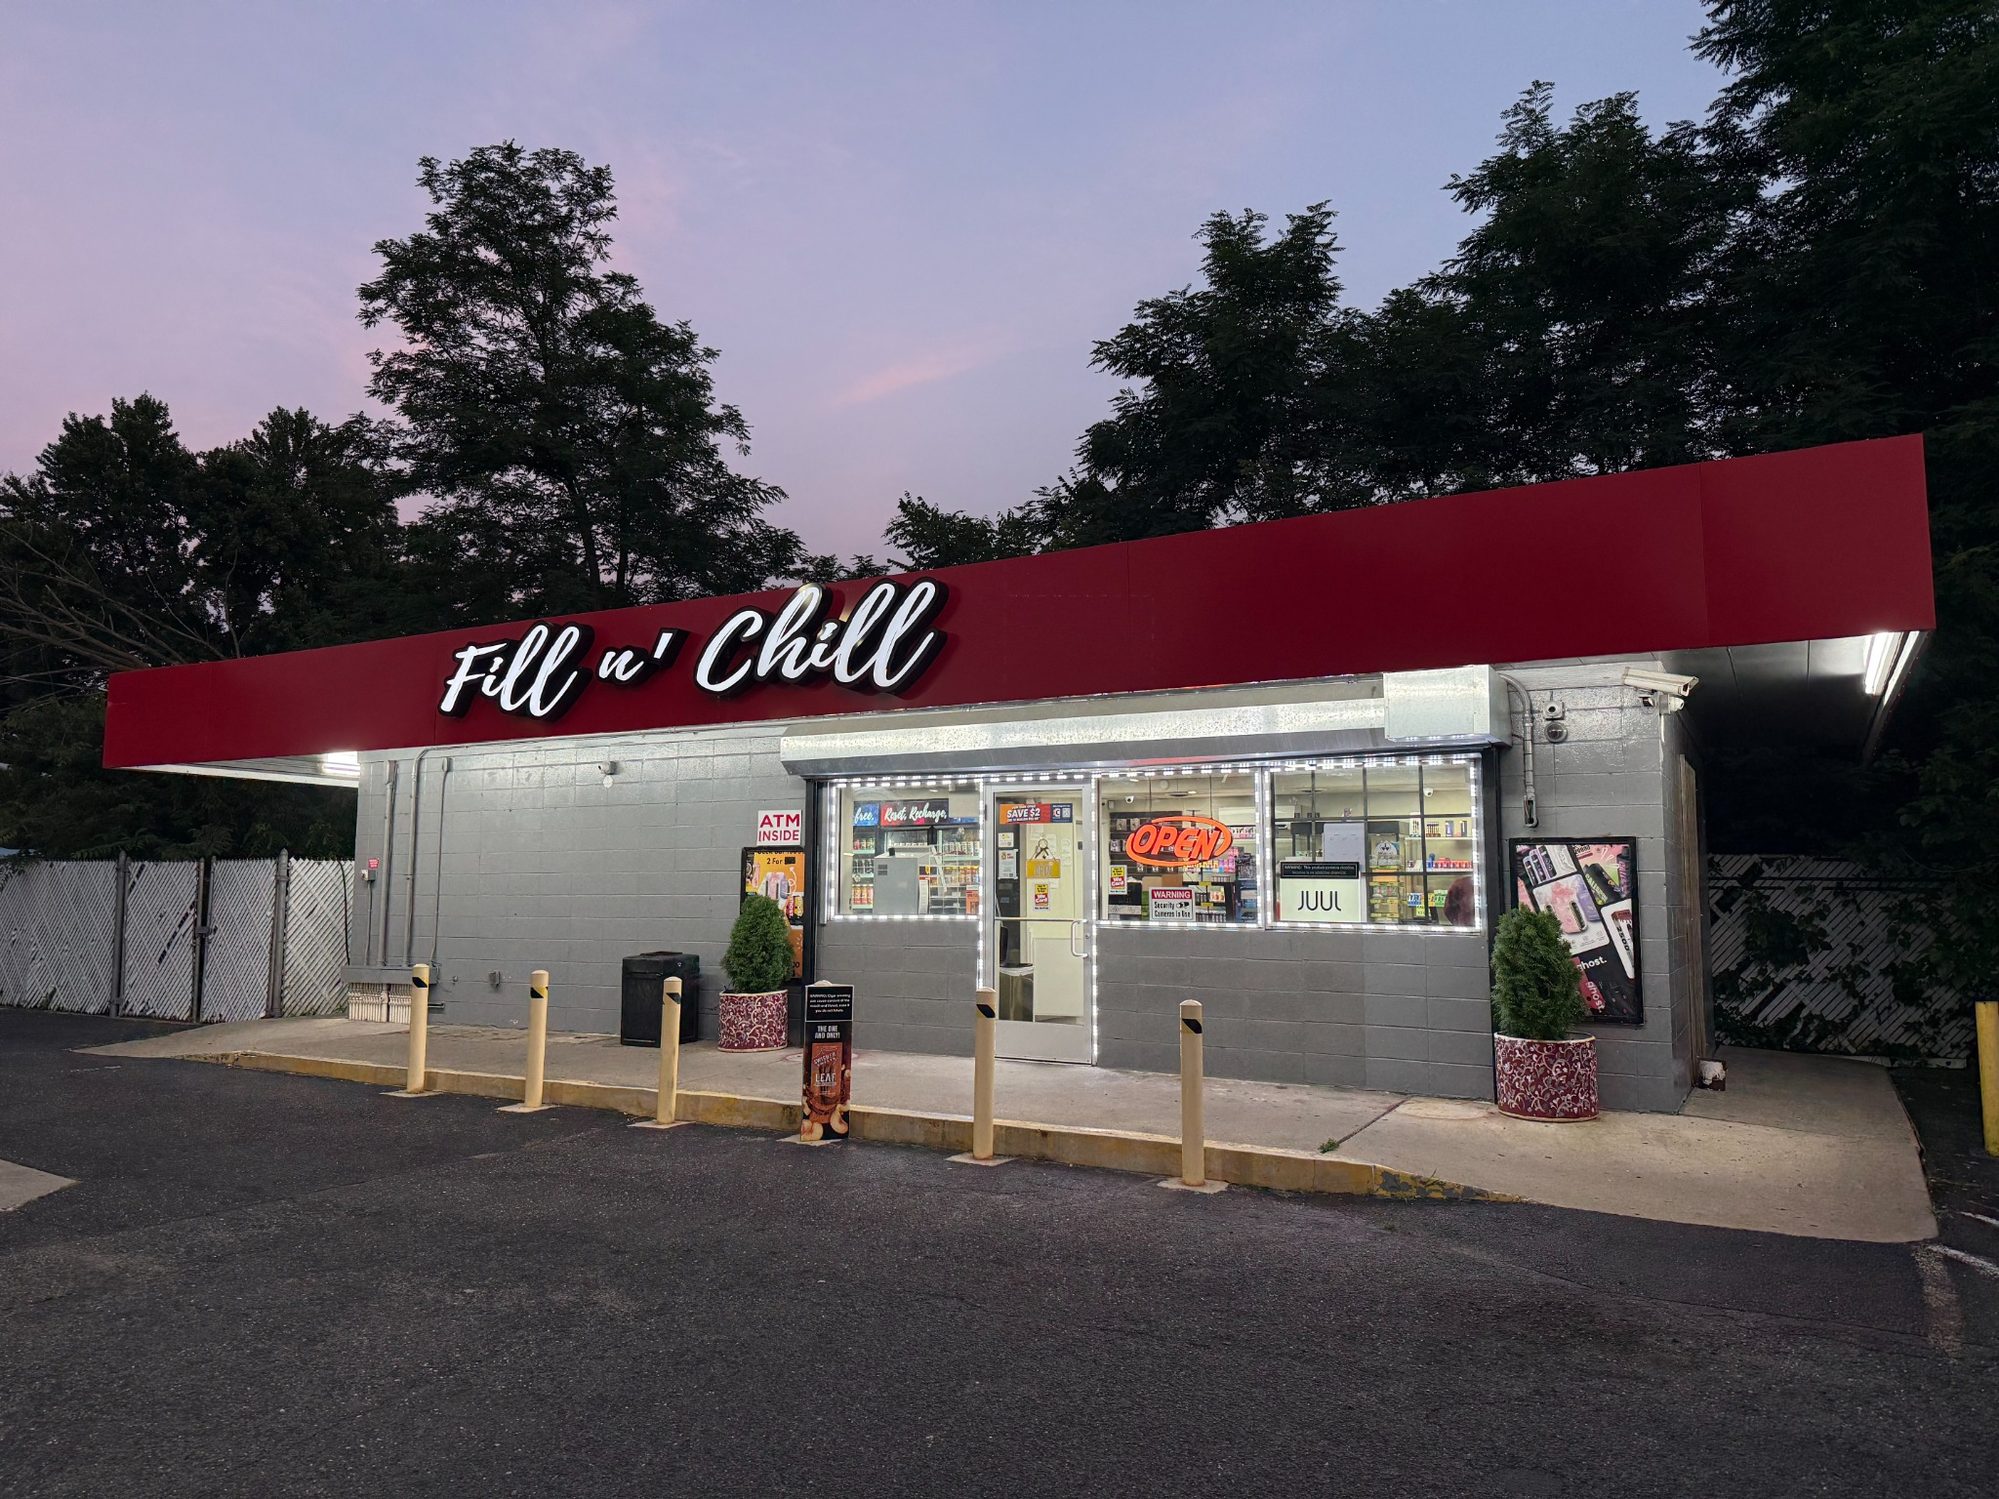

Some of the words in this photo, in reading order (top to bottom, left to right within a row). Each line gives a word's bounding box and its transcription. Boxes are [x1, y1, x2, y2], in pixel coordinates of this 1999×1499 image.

[440, 623, 578, 717] Fill
[599, 632, 673, 681] n'
[698, 581, 936, 692] Chill
[1006, 809, 1028, 818] SAVE
[1029, 807, 1041, 817] $2
[760, 813, 800, 828] ATM
[758, 830, 799, 842] INSIDE
[1132, 824, 1221, 861] OPEN
[766, 857, 771, 865] 2
[772, 857, 783, 865] For
[1153, 890, 1191, 899] WARNING
[1154, 901, 1175, 910] Security
[1297, 890, 1342, 911] JUUL
[1154, 910, 1175, 918] Cameras
[1182, 910, 1191, 918] Use
[1616, 925, 1631, 952] 2500
[815, 1073, 836, 1083] LEAF
